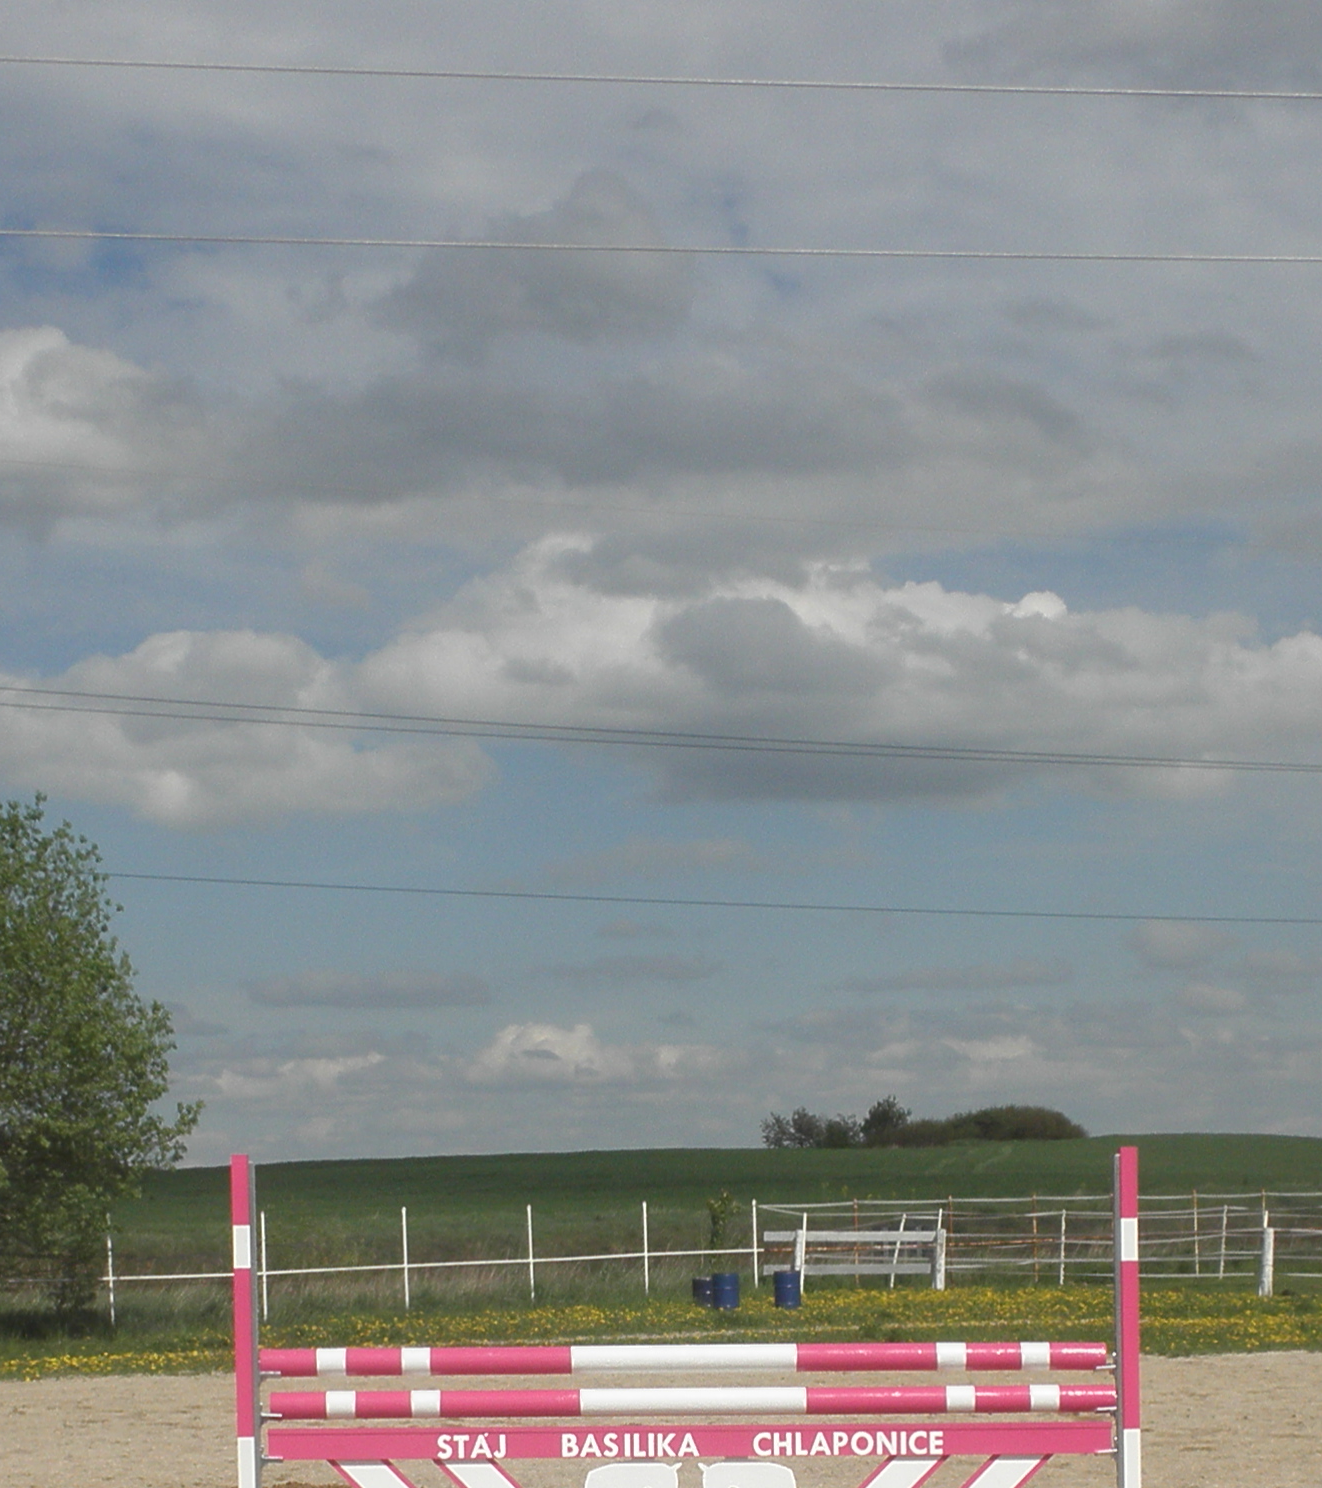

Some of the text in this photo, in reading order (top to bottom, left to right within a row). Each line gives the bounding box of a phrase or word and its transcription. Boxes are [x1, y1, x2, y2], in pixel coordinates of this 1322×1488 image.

[436, 1430, 944, 1459] STÁJ BASILIKA CHLAPONICE
